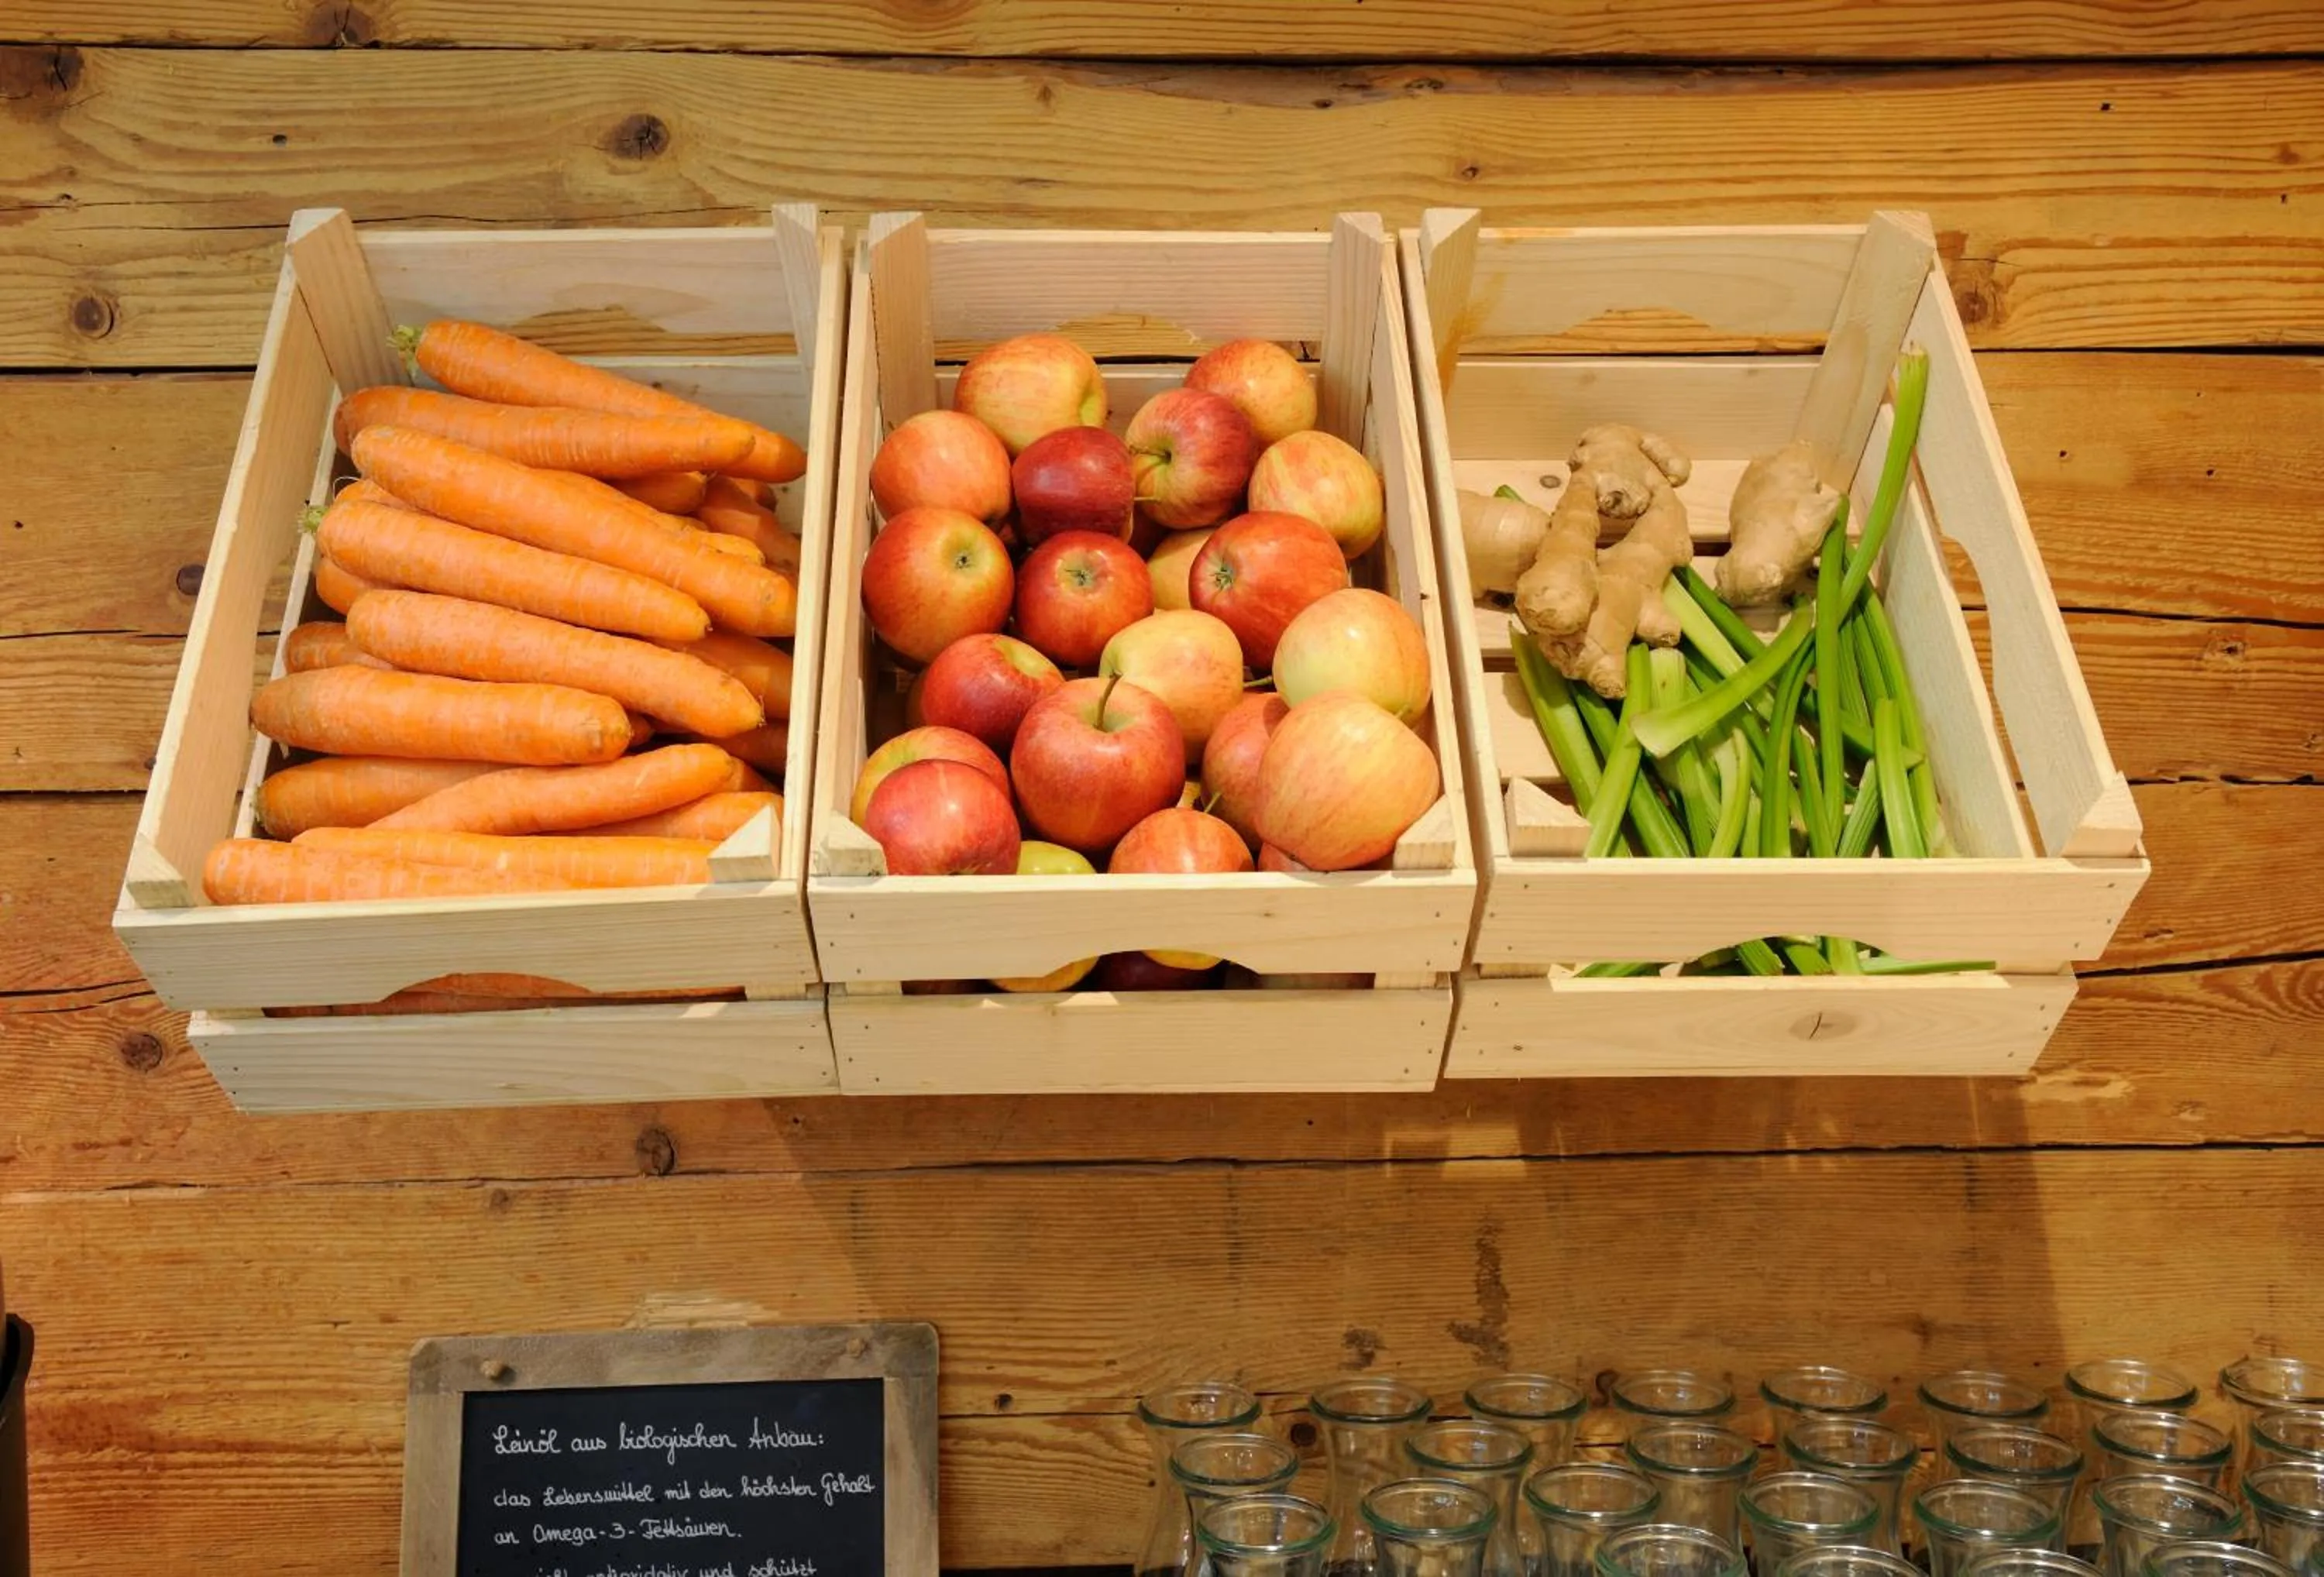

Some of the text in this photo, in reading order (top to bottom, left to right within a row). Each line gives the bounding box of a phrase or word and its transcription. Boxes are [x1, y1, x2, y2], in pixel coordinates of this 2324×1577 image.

[493, 1417, 824, 1465] Leinöl aus biologischen Anbau:
[493, 1472, 877, 1507] das Lebensmittel mit den höchsten Gehalt
[494, 1531, 520, 1544] an
[699, 1562, 735, 1577] und
[747, 1556, 818, 1577] schützt
